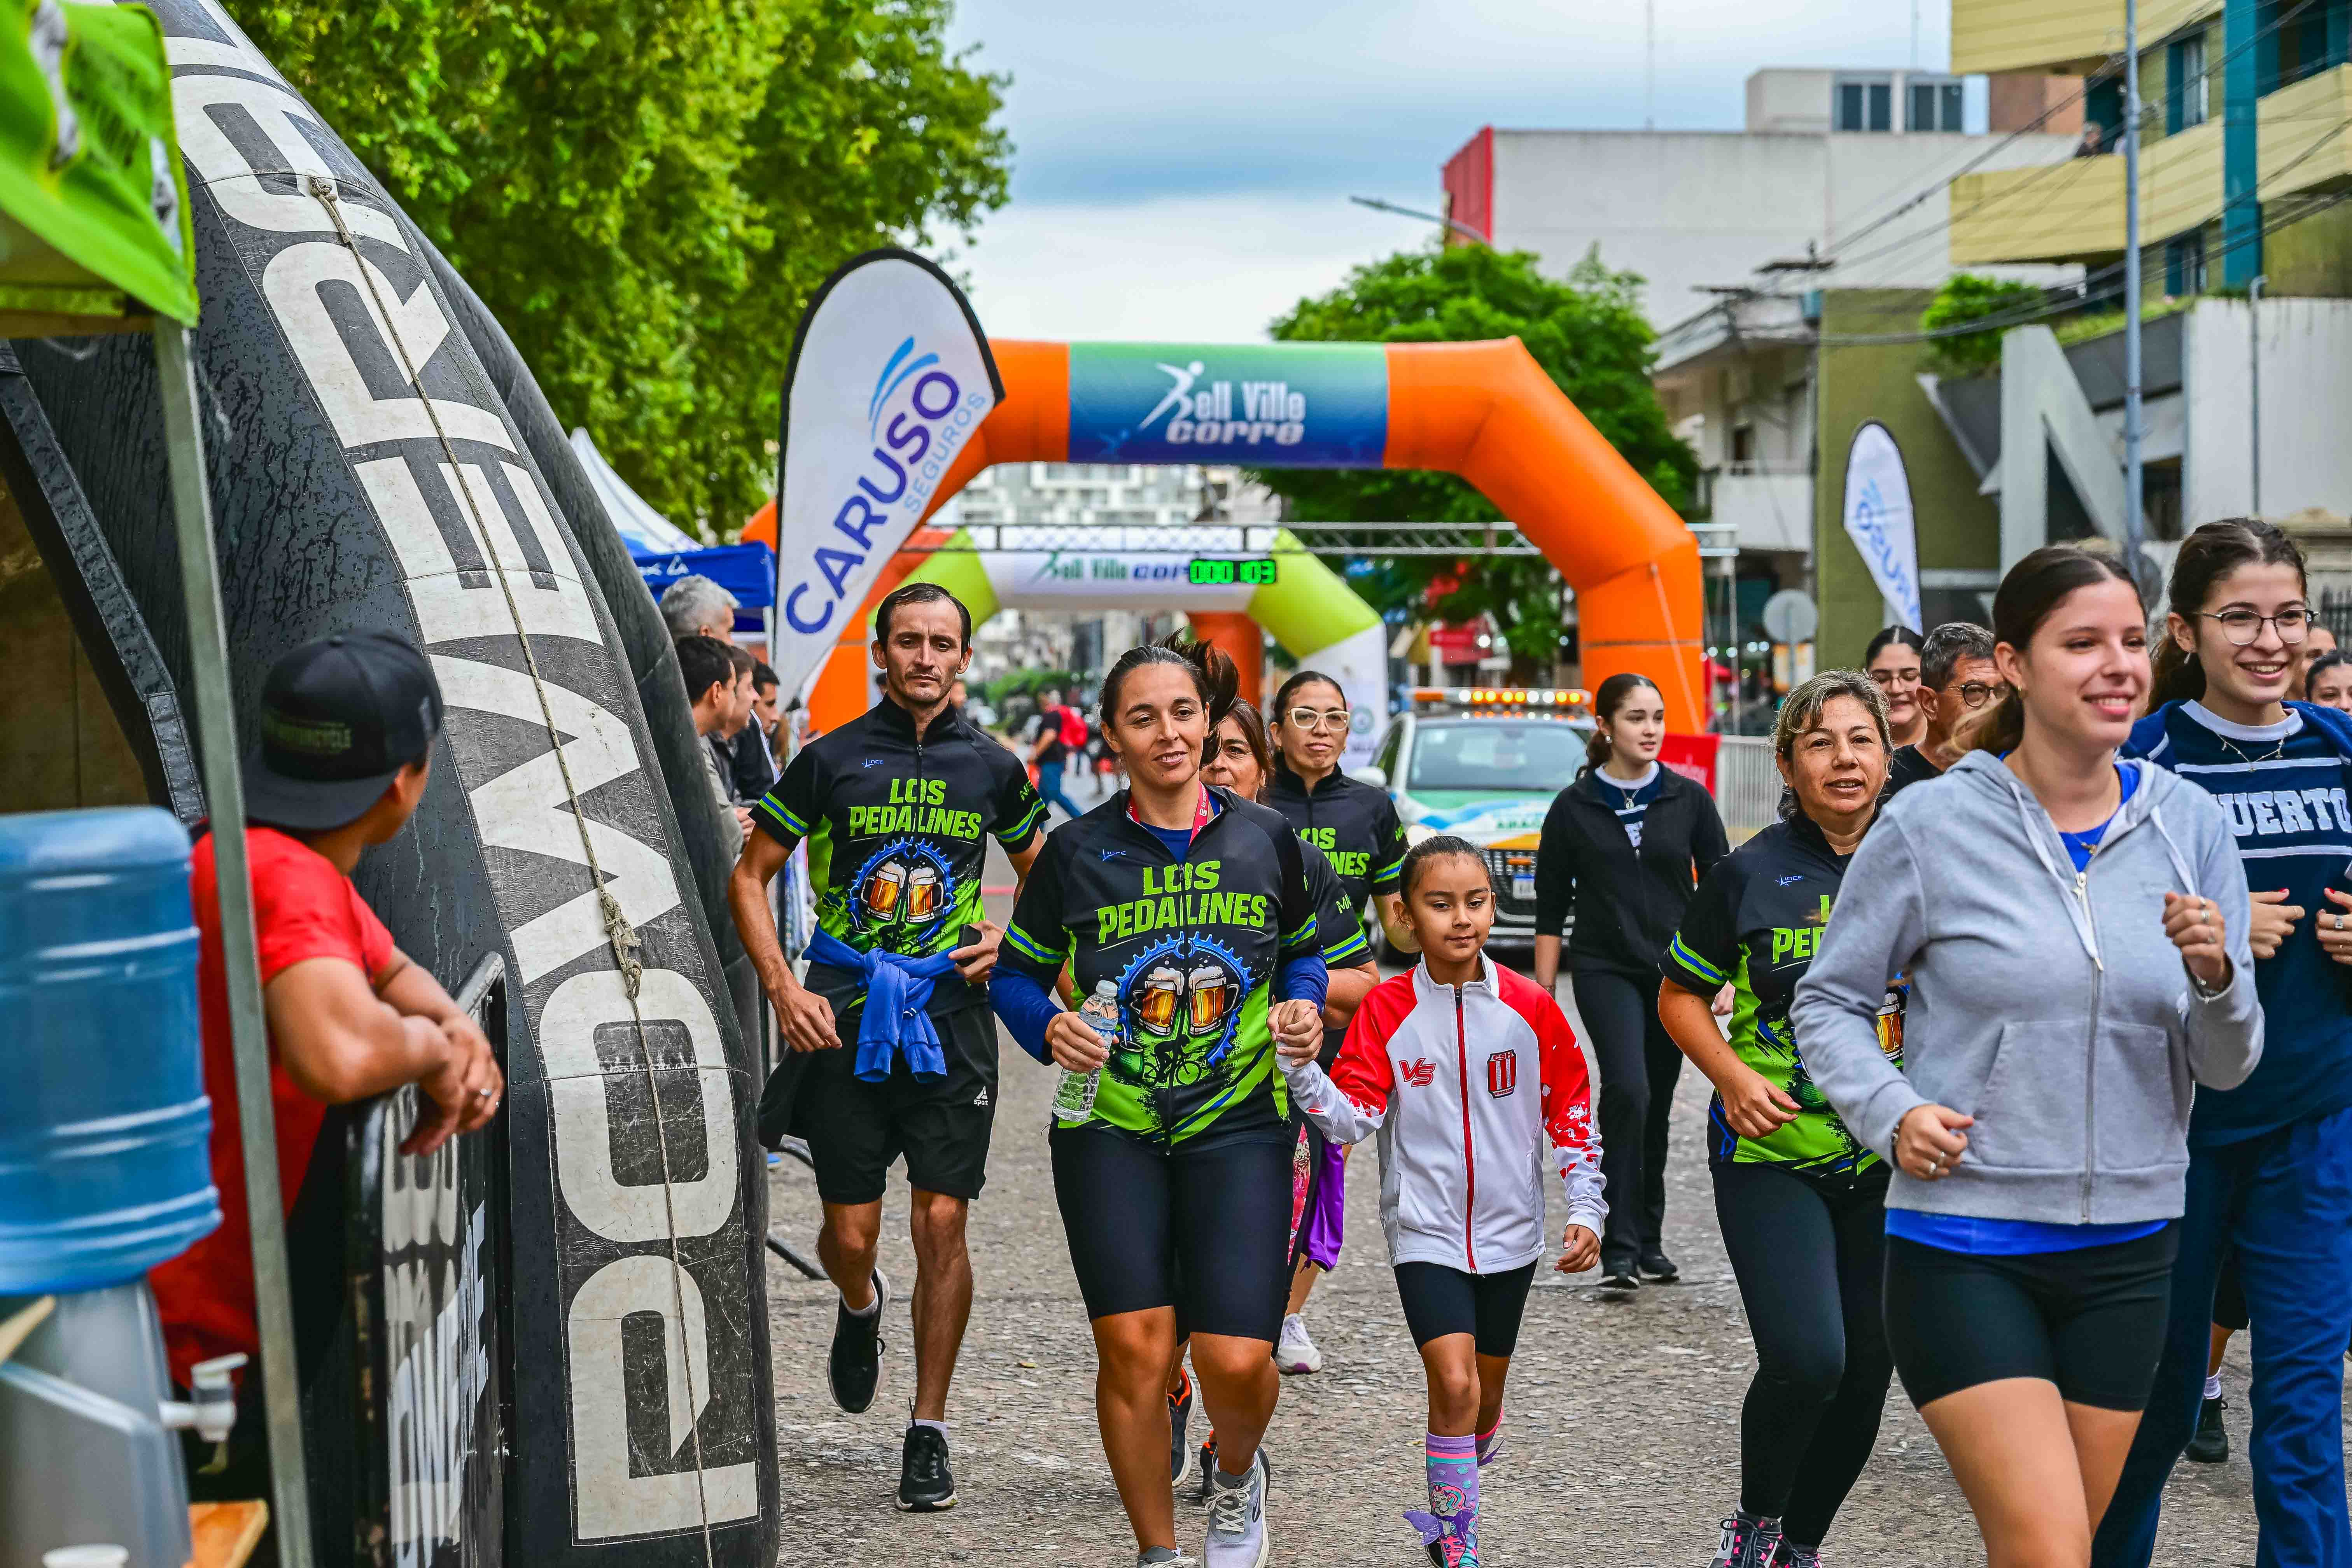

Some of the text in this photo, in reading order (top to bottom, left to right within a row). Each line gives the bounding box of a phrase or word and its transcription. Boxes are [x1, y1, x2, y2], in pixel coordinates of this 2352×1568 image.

[1242, 380, 1306, 421] Ville
[903, 391, 986, 514] SEGUROS
[786, 371, 960, 634] CARUSO
[890, 778, 947, 805] LOS
[2213, 788, 2352, 836] UERTO
[849, 806, 981, 839] PEDALINES
[1143, 860, 1221, 896] LOS
[1097, 893, 1267, 944] PEDALINES
[1398, 1057, 1436, 1088] VS
